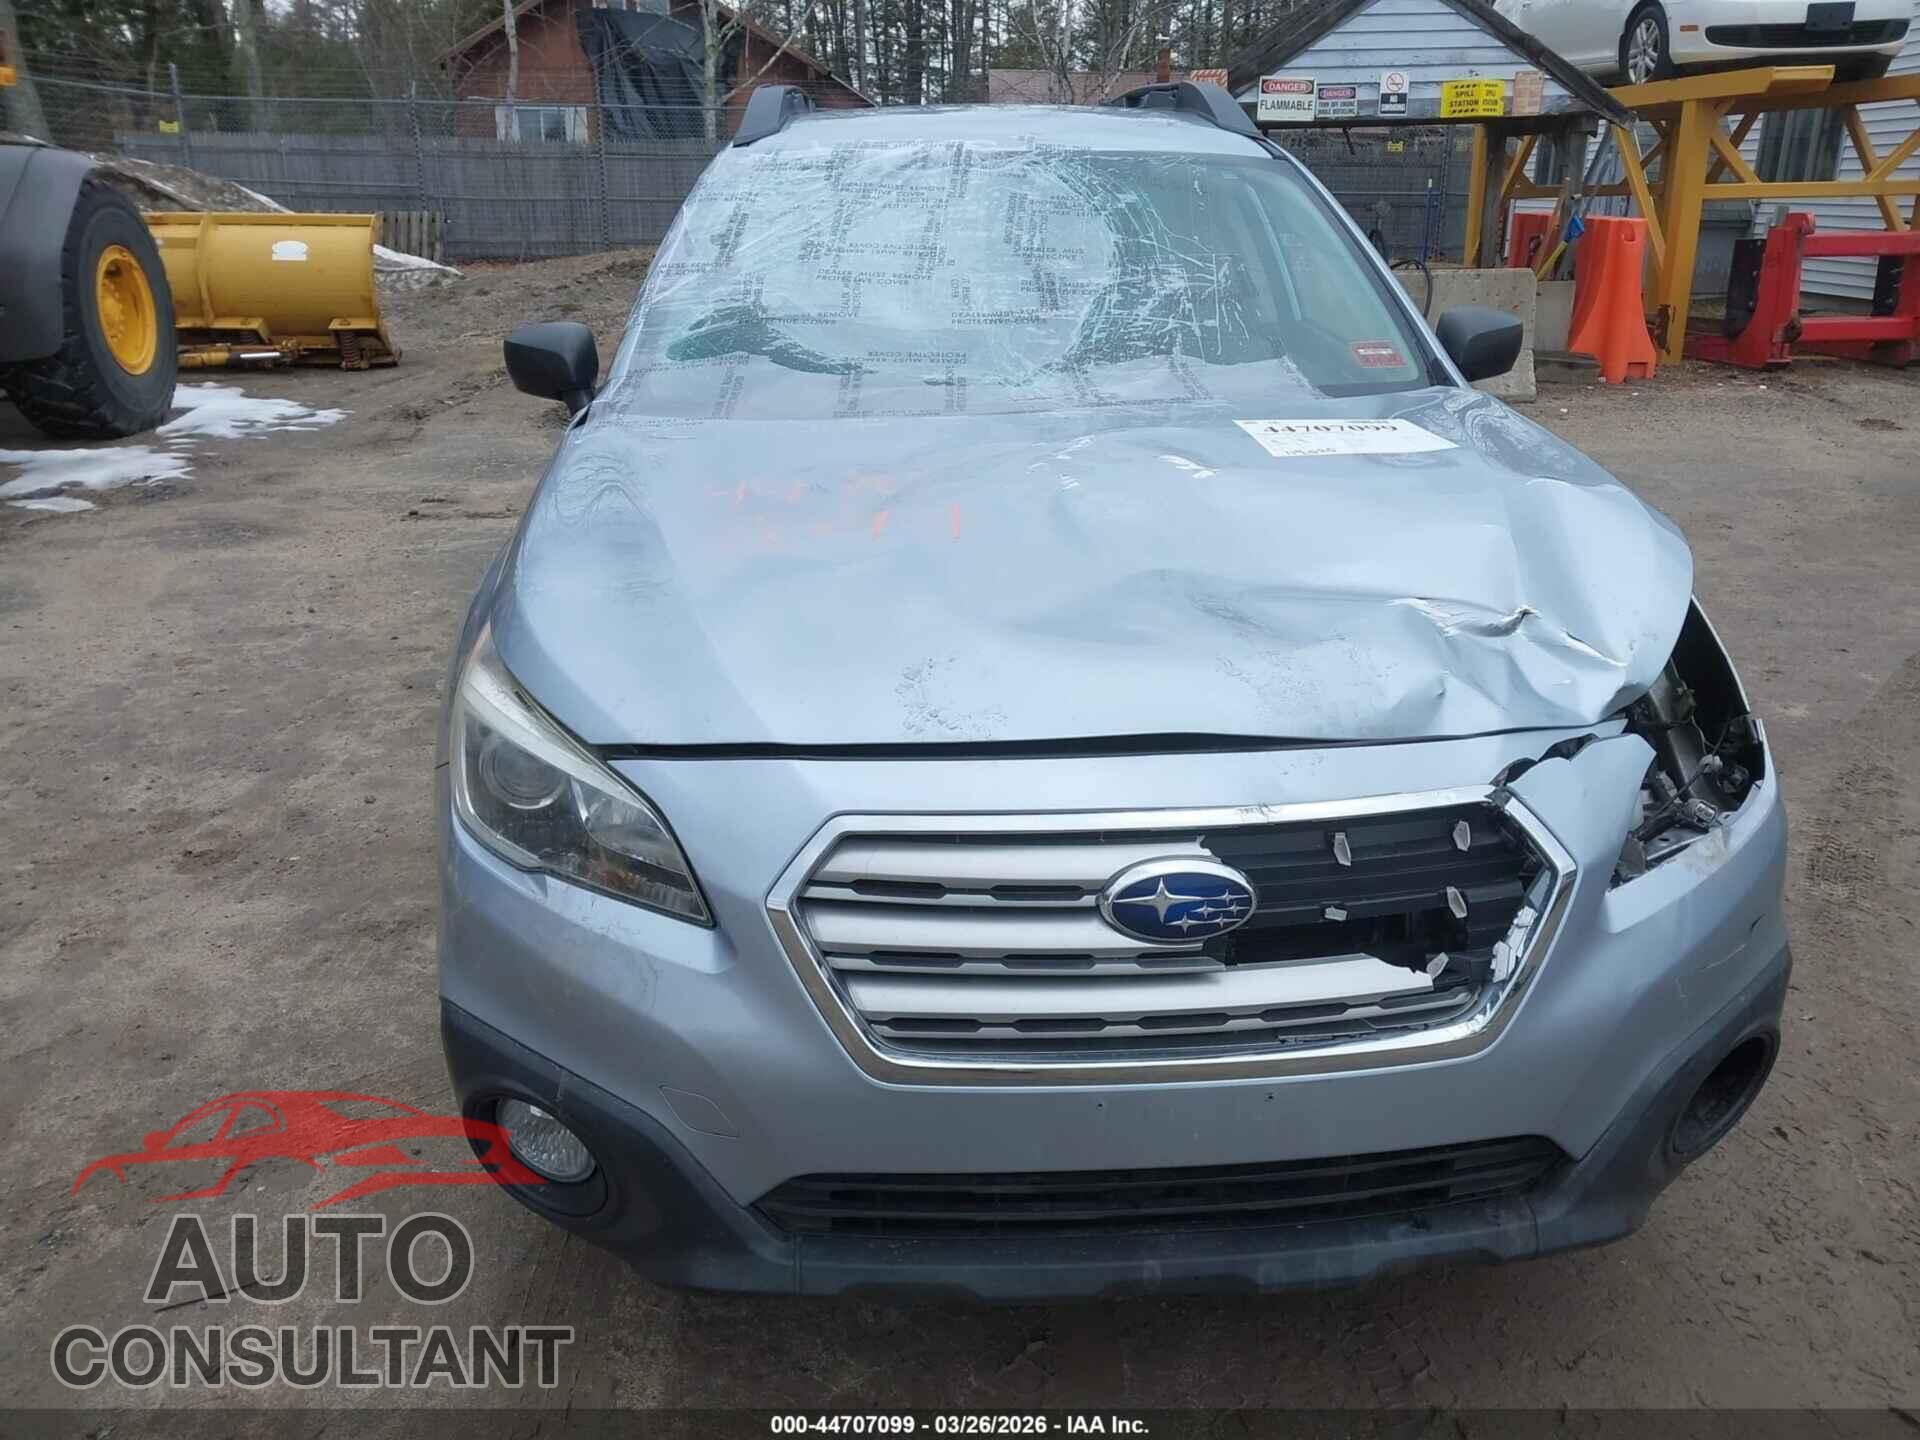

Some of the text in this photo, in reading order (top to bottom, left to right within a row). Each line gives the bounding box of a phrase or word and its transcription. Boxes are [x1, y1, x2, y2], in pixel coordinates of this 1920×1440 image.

[1268, 82, 1307, 92] DANGER
[1259, 99, 1314, 111] FLAMMABLE
[1450, 99, 1480, 107] STATION
[1263, 423, 1399, 433] 44707099
